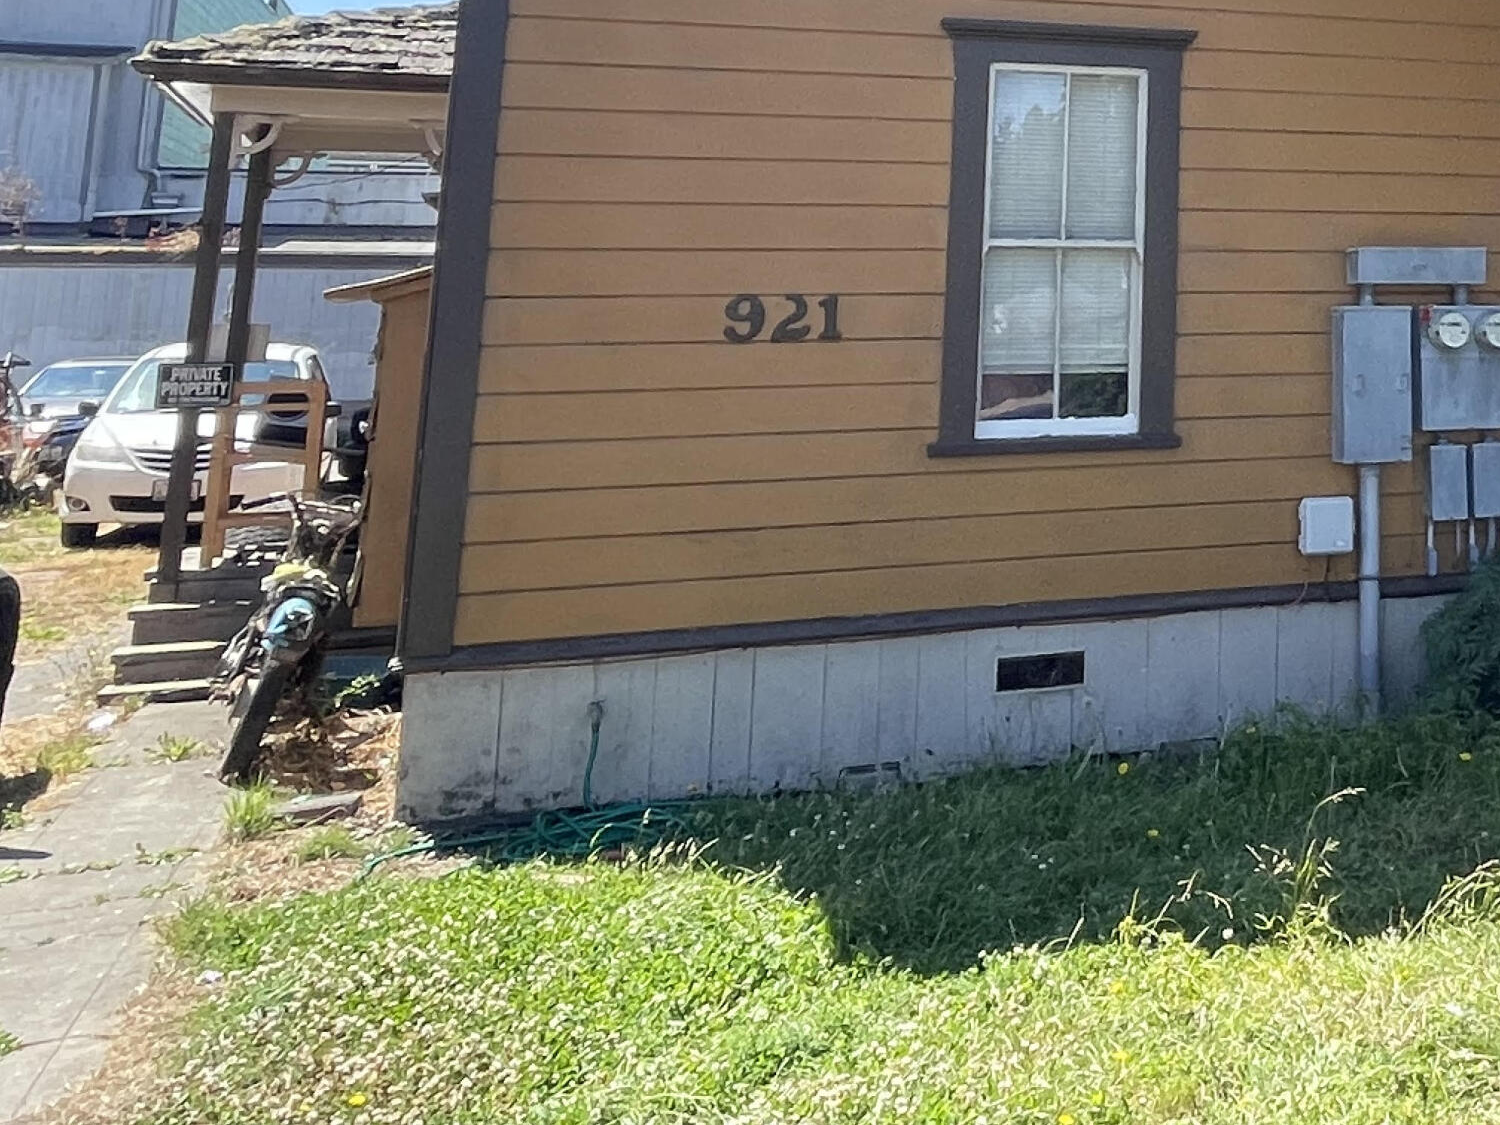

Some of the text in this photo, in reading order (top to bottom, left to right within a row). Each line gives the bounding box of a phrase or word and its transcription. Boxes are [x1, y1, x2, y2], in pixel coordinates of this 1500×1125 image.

[723, 293, 842, 343] 921
[170, 367, 222, 381] PRIVATE
[161, 381, 229, 396] PROPERTY
